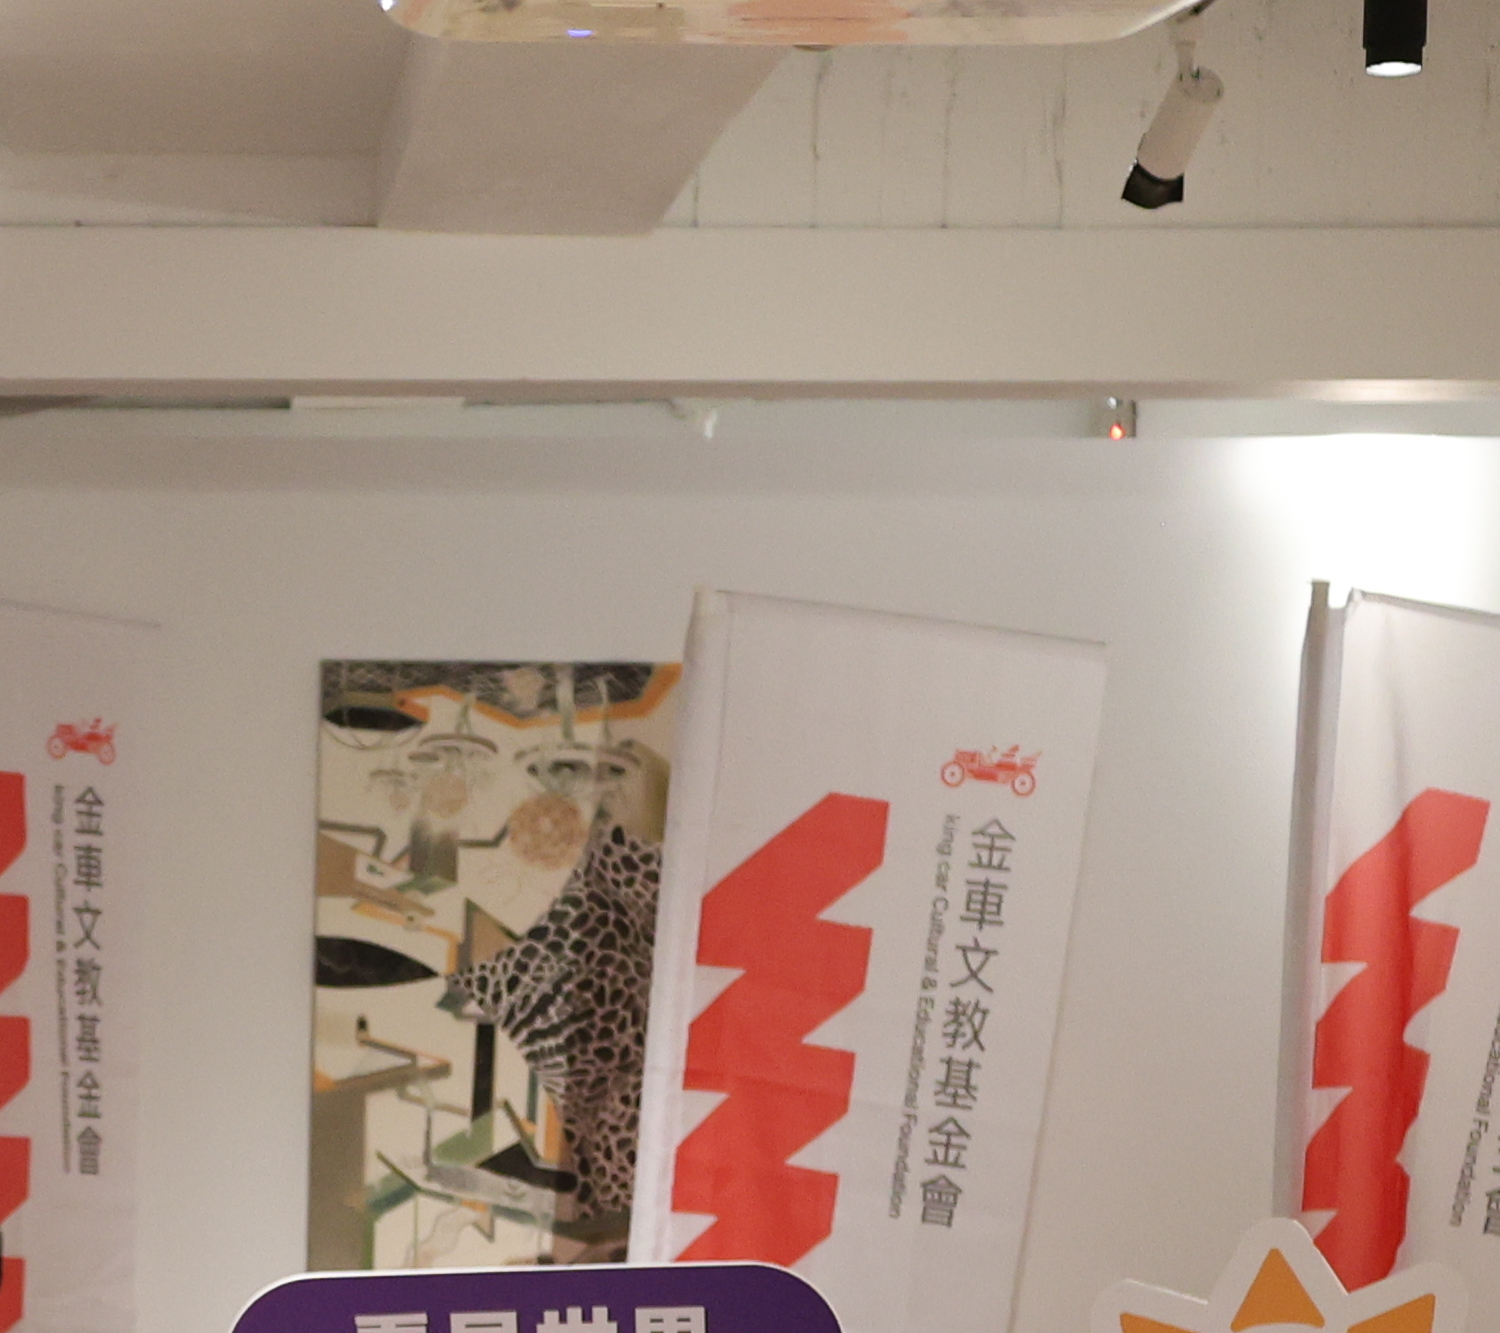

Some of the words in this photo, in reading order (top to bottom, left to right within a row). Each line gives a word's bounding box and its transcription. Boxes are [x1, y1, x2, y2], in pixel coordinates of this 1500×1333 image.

[73, 786, 104, 1175] 金車文教基金會
[920, 818, 1016, 1228] 金車文教基金會
